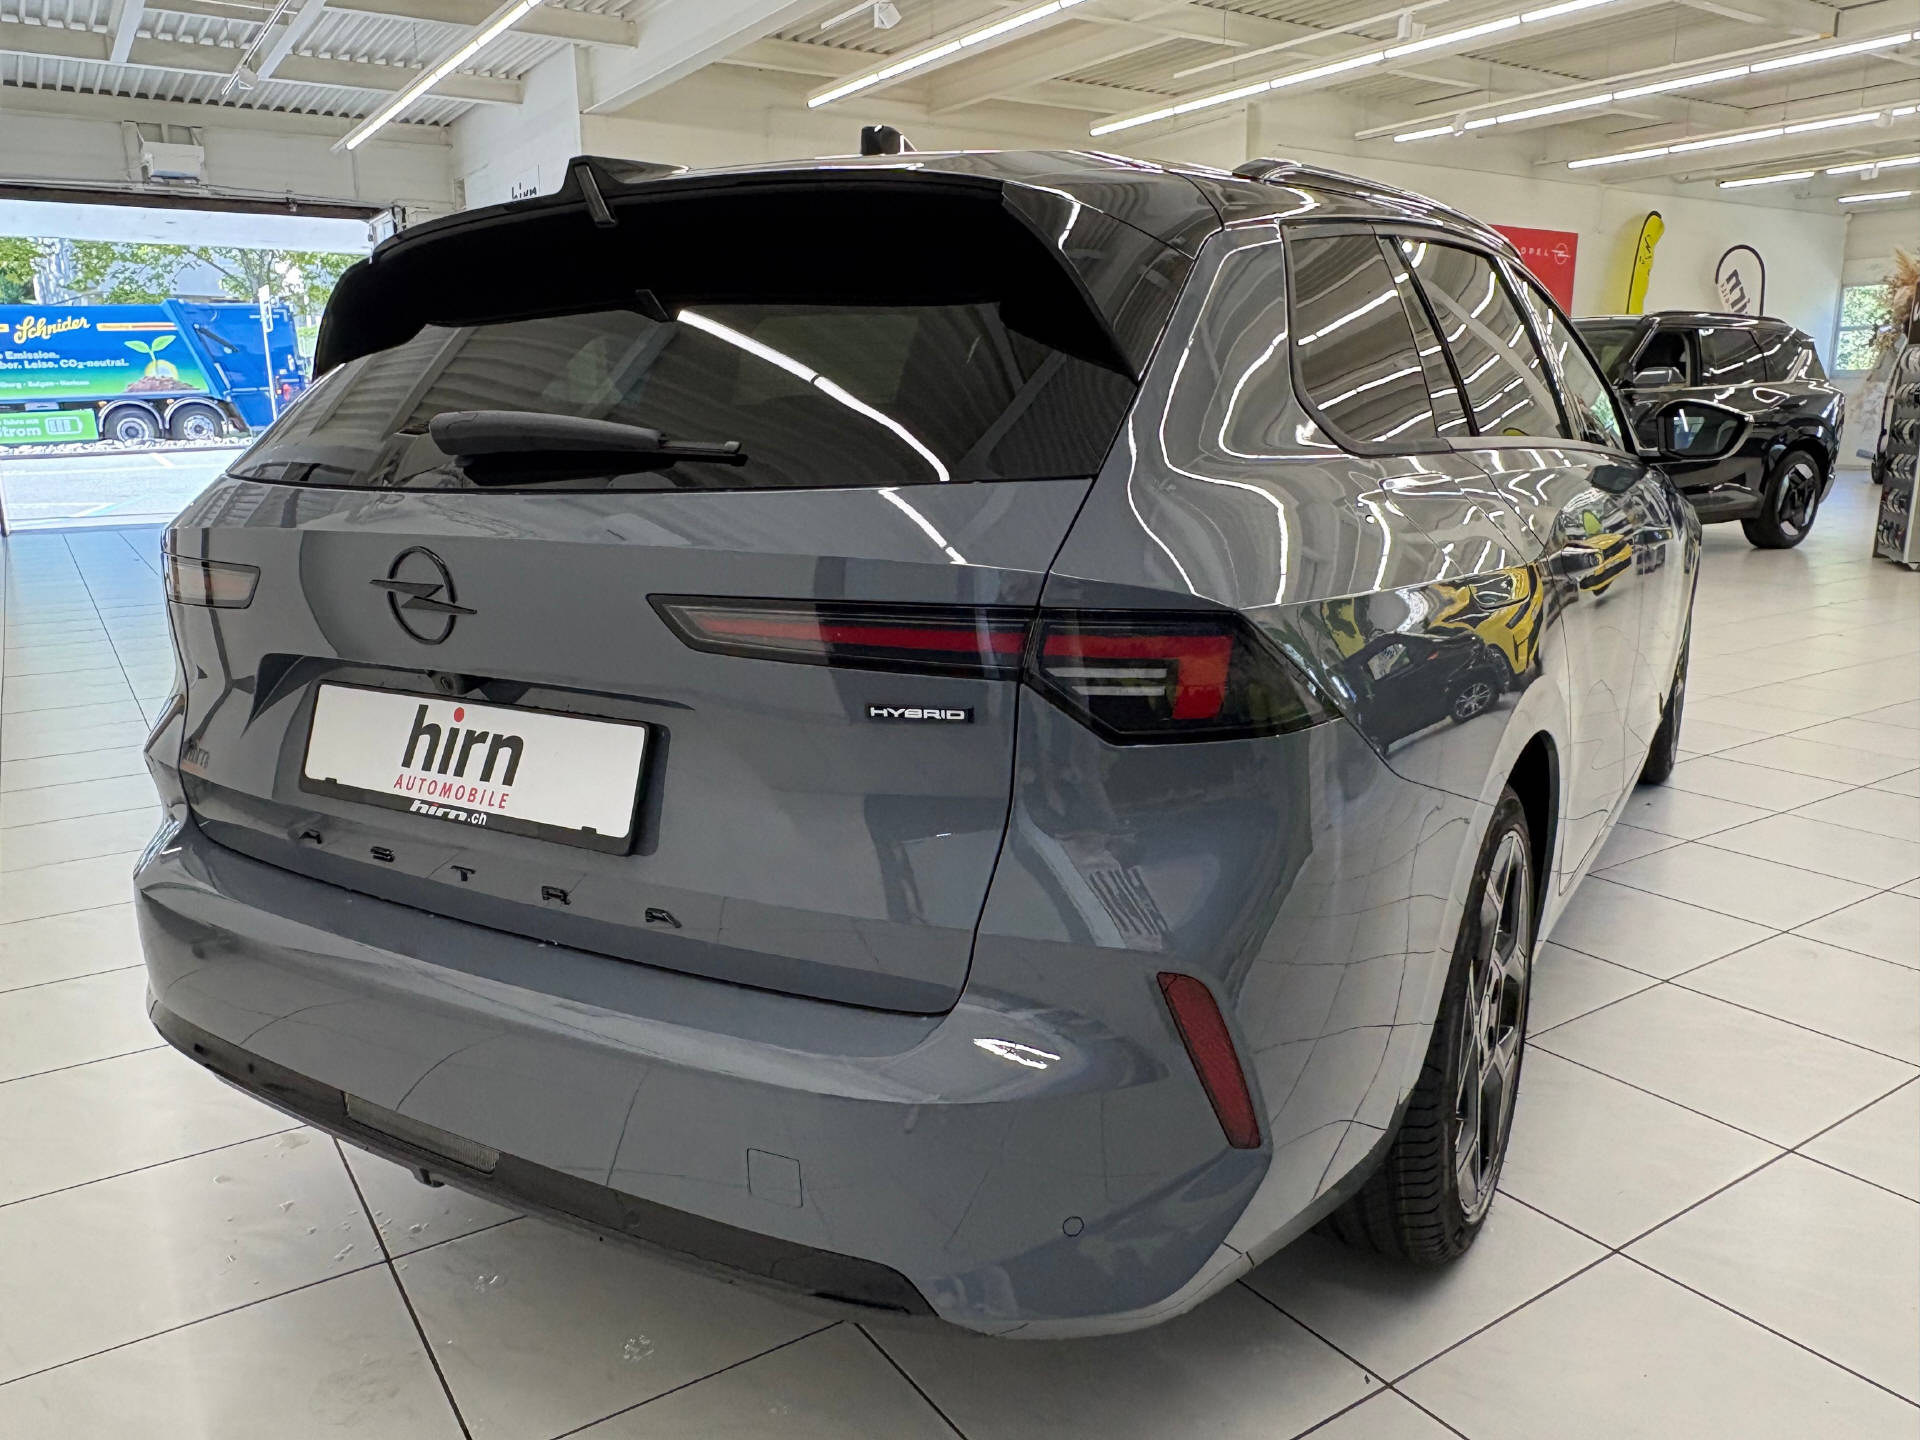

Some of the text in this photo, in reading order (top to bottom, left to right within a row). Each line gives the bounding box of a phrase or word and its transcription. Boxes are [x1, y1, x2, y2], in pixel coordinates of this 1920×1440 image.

[1520, 246, 1549, 257] OPEL
[14, 316, 91, 344] Schnider
[870, 706, 965, 720] HYBRID
[401, 703, 524, 787] hirn
[393, 773, 510, 809] AUTOMOBILE
[409, 799, 488, 826] hirn.ch
